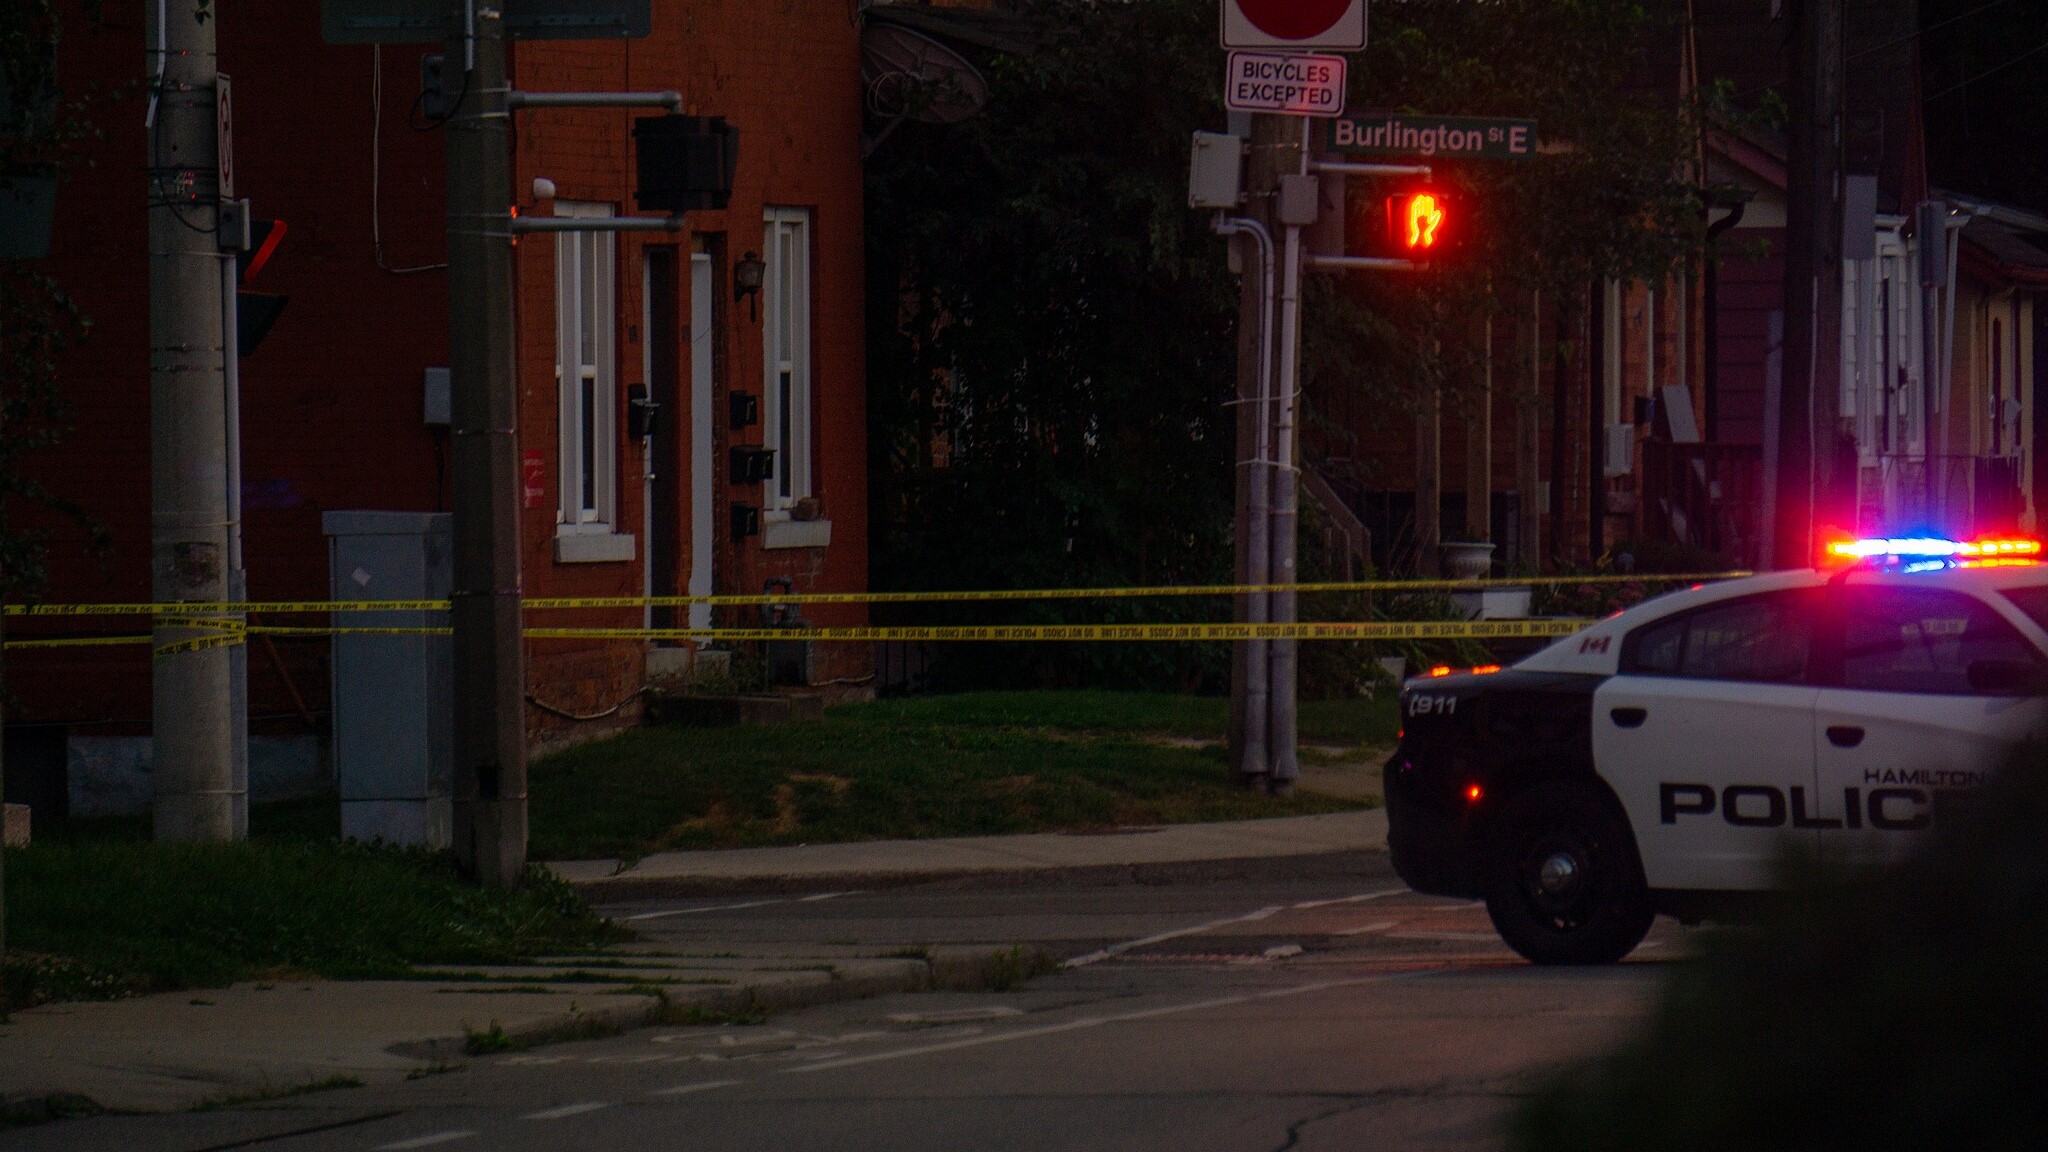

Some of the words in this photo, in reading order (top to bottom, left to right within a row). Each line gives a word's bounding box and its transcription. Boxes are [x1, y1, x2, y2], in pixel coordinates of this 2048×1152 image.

[1243, 61, 1330, 83] BICYCLES
[1237, 83, 1333, 105] EXCEPTED
[1335, 119, 1483, 155] Burlington
[1488, 127, 1504, 142] St
[1509, 126, 1528, 154] E
[1416, 695, 1458, 716] 911
[1864, 768, 1985, 786] HAMILTON
[1659, 782, 1945, 831] POLIC
